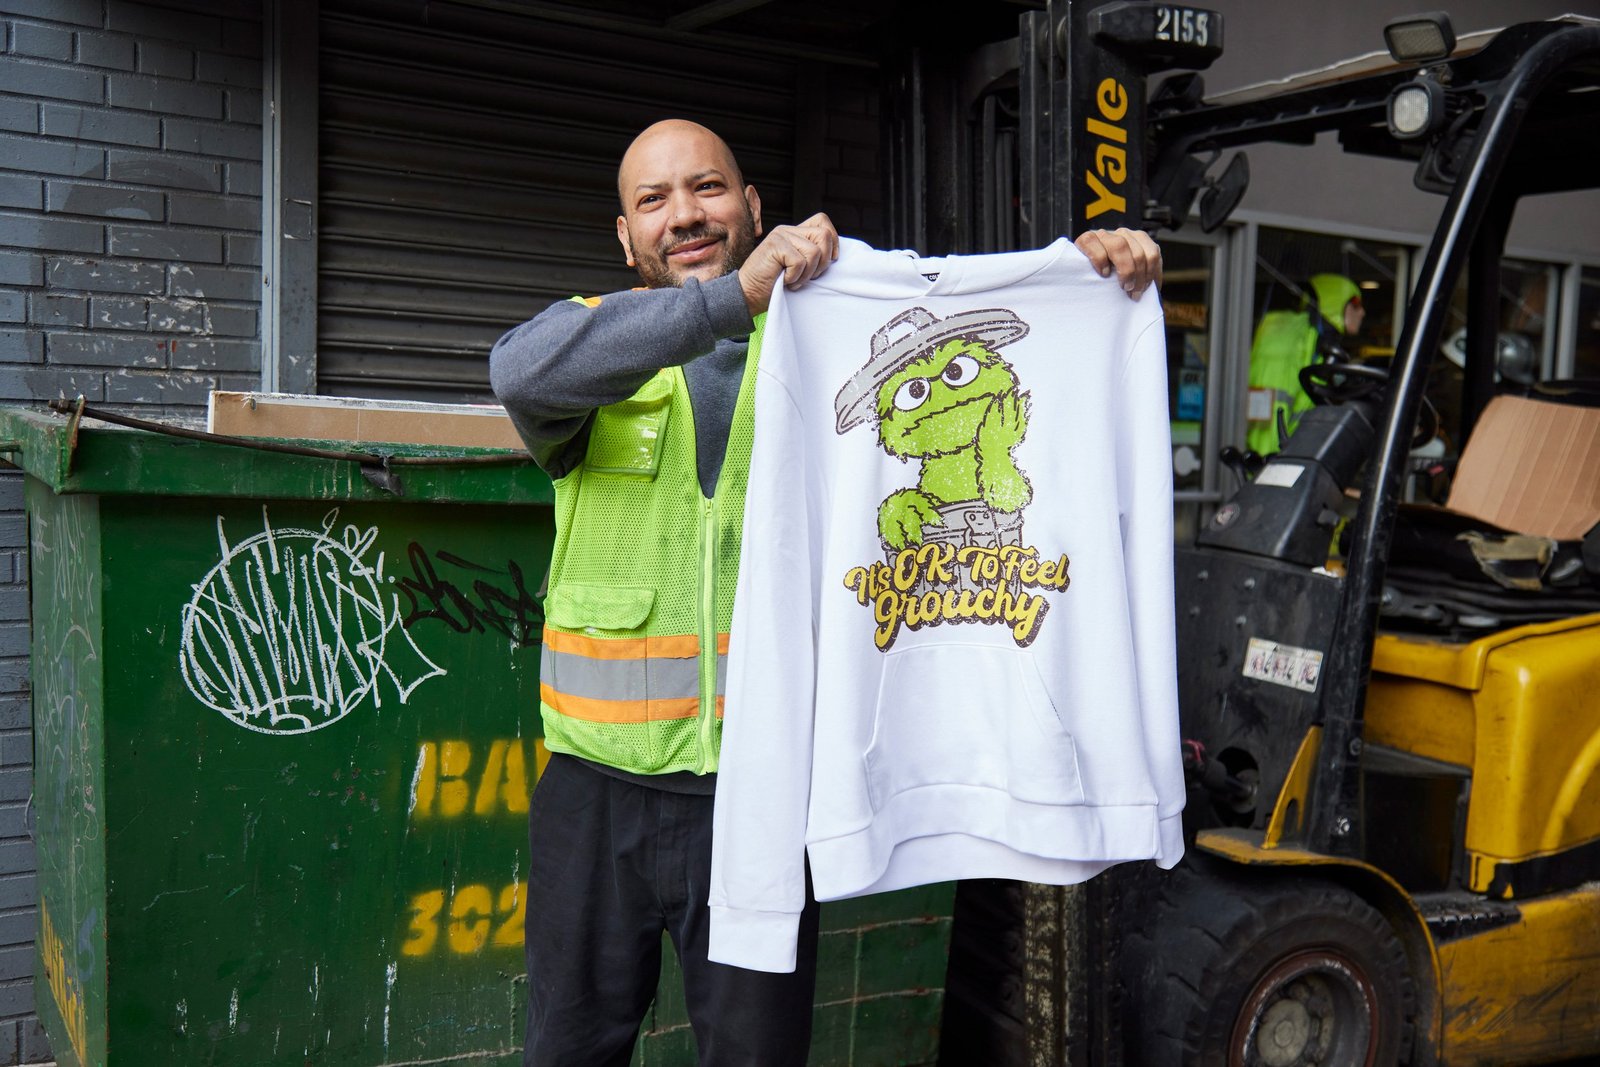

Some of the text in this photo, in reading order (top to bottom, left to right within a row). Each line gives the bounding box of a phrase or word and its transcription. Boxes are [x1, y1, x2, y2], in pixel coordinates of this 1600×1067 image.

[1086, 77, 1128, 220] Yale
[843, 543, 1070, 606] It's OK To Feel
